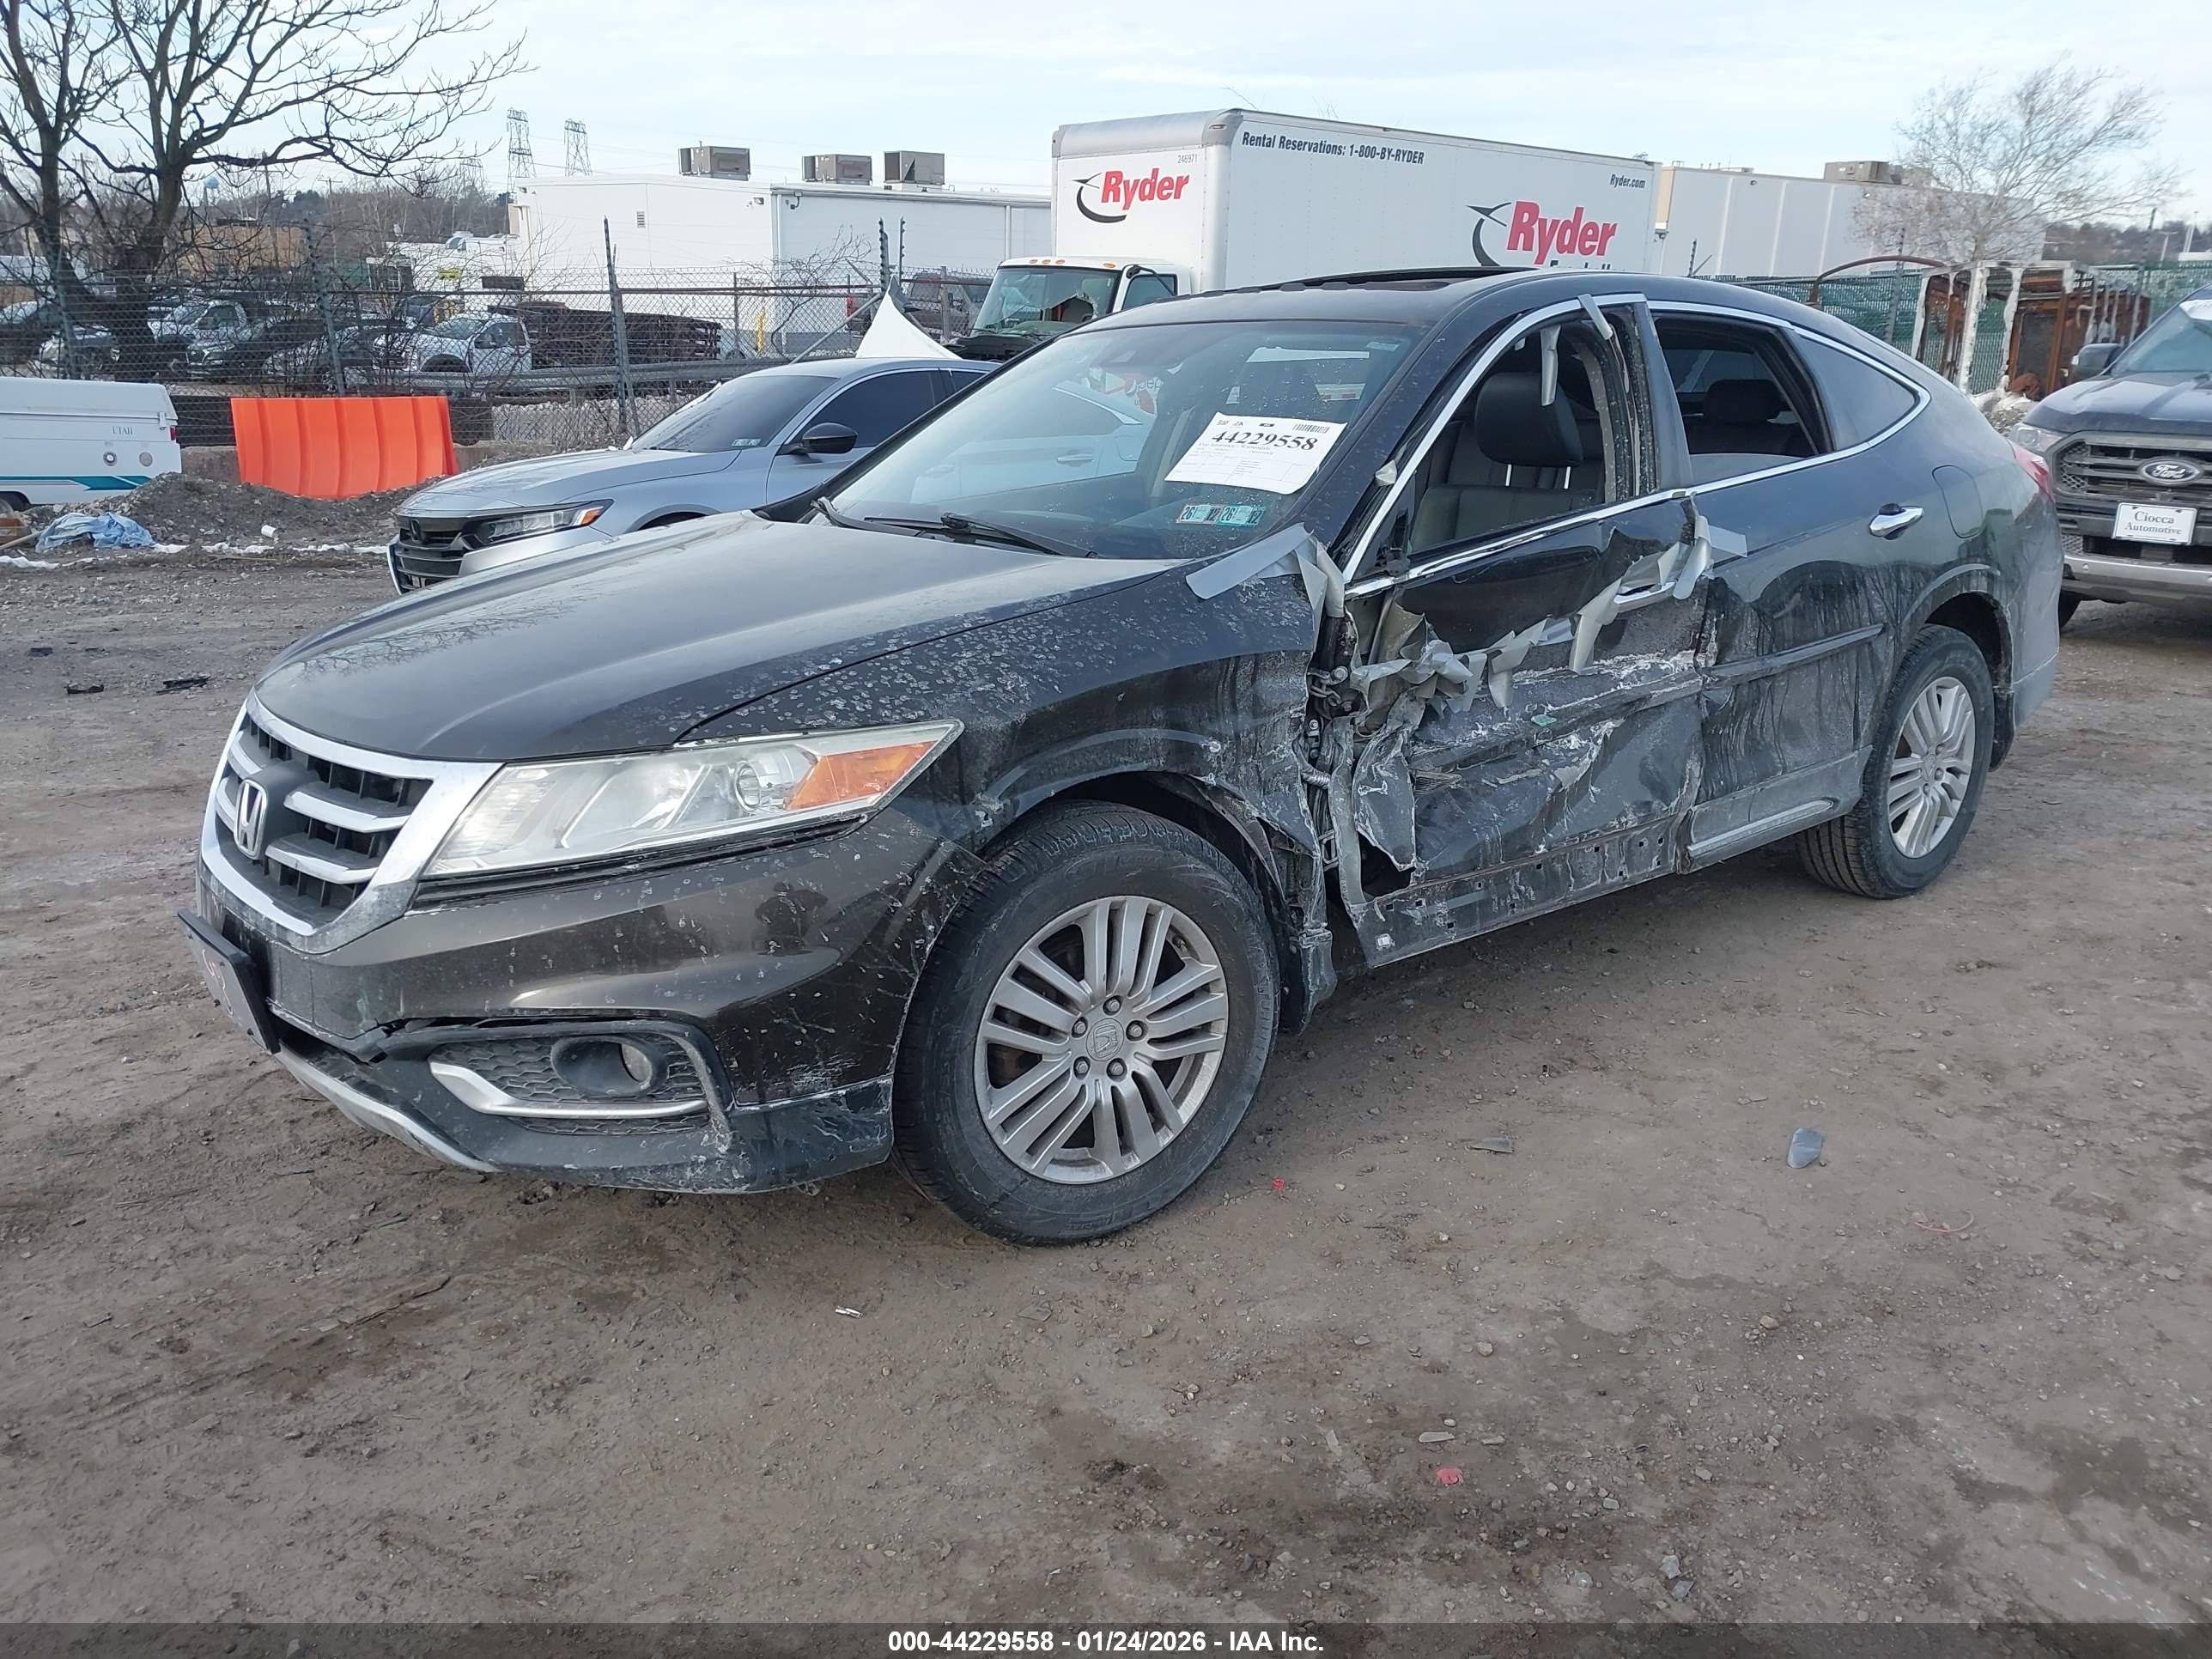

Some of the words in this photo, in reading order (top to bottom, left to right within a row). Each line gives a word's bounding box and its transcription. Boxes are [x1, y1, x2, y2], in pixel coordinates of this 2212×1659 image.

[1242, 131, 1277, 149] Rental
[1279, 136, 1346, 156] Reservations:
[1349, 144, 1425, 165] 1-800-BY-RYDER
[1101, 167, 1190, 211] Ryder
[1609, 173, 1646, 189] Ryder.com
[1506, 200, 1618, 265] Ryder
[112, 425, 133, 435] UTAH
[1212, 431, 1319, 451] 44229558
[2152, 465, 2186, 478] Ford
[2135, 511, 2174, 524] Ciocca
[2124, 522, 2183, 535] Automotive
